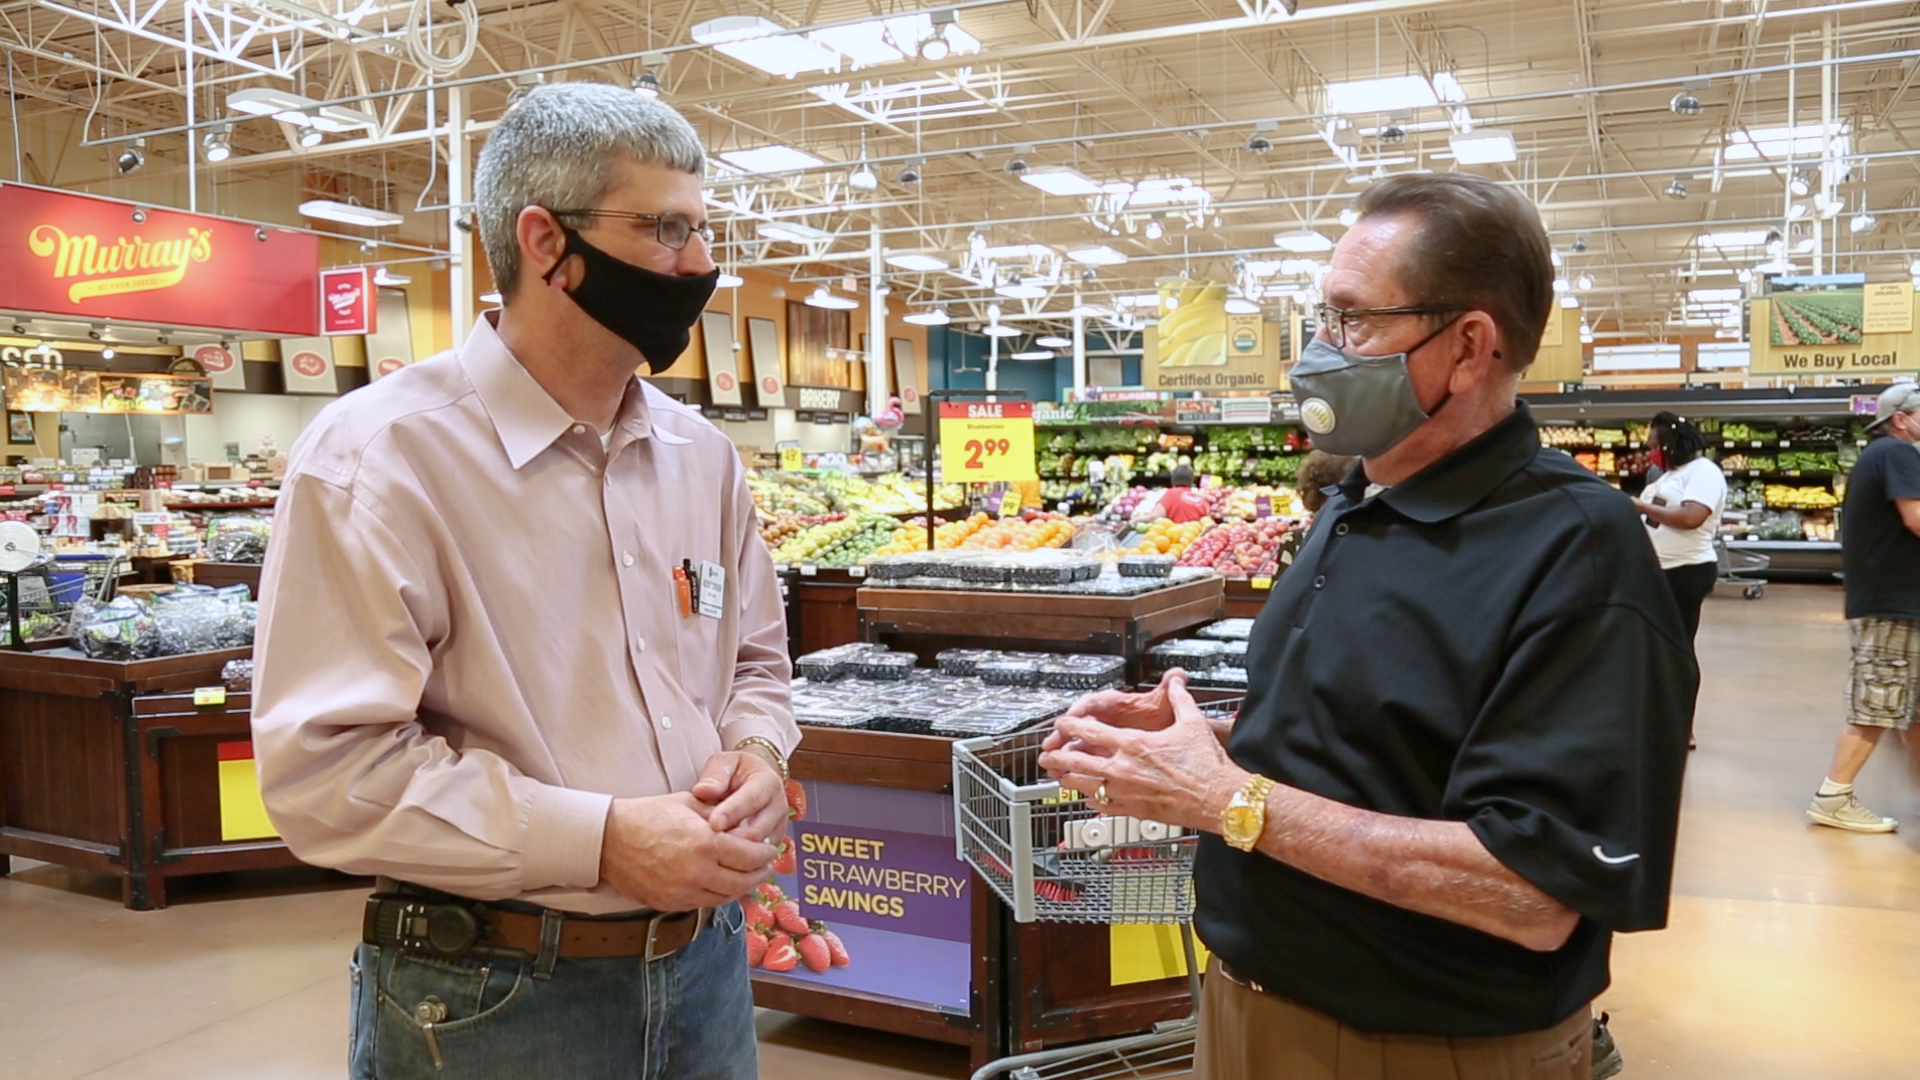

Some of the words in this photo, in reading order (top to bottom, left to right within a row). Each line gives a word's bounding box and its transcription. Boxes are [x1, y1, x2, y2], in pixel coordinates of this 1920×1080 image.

[29, 224, 213, 290] Murray's
[1784, 354, 1808, 367] We
[1814, 353, 1845, 369] Buy
[1852, 352, 1897, 366] Local
[1158, 373, 1211, 387] Certified
[1215, 372, 1265, 388] Organic
[968, 404, 1003, 418] SALE
[801, 833, 885, 860] SWEET
[803, 859, 967, 898] STRAWBERRY
[804, 884, 905, 917] SAVINGS
